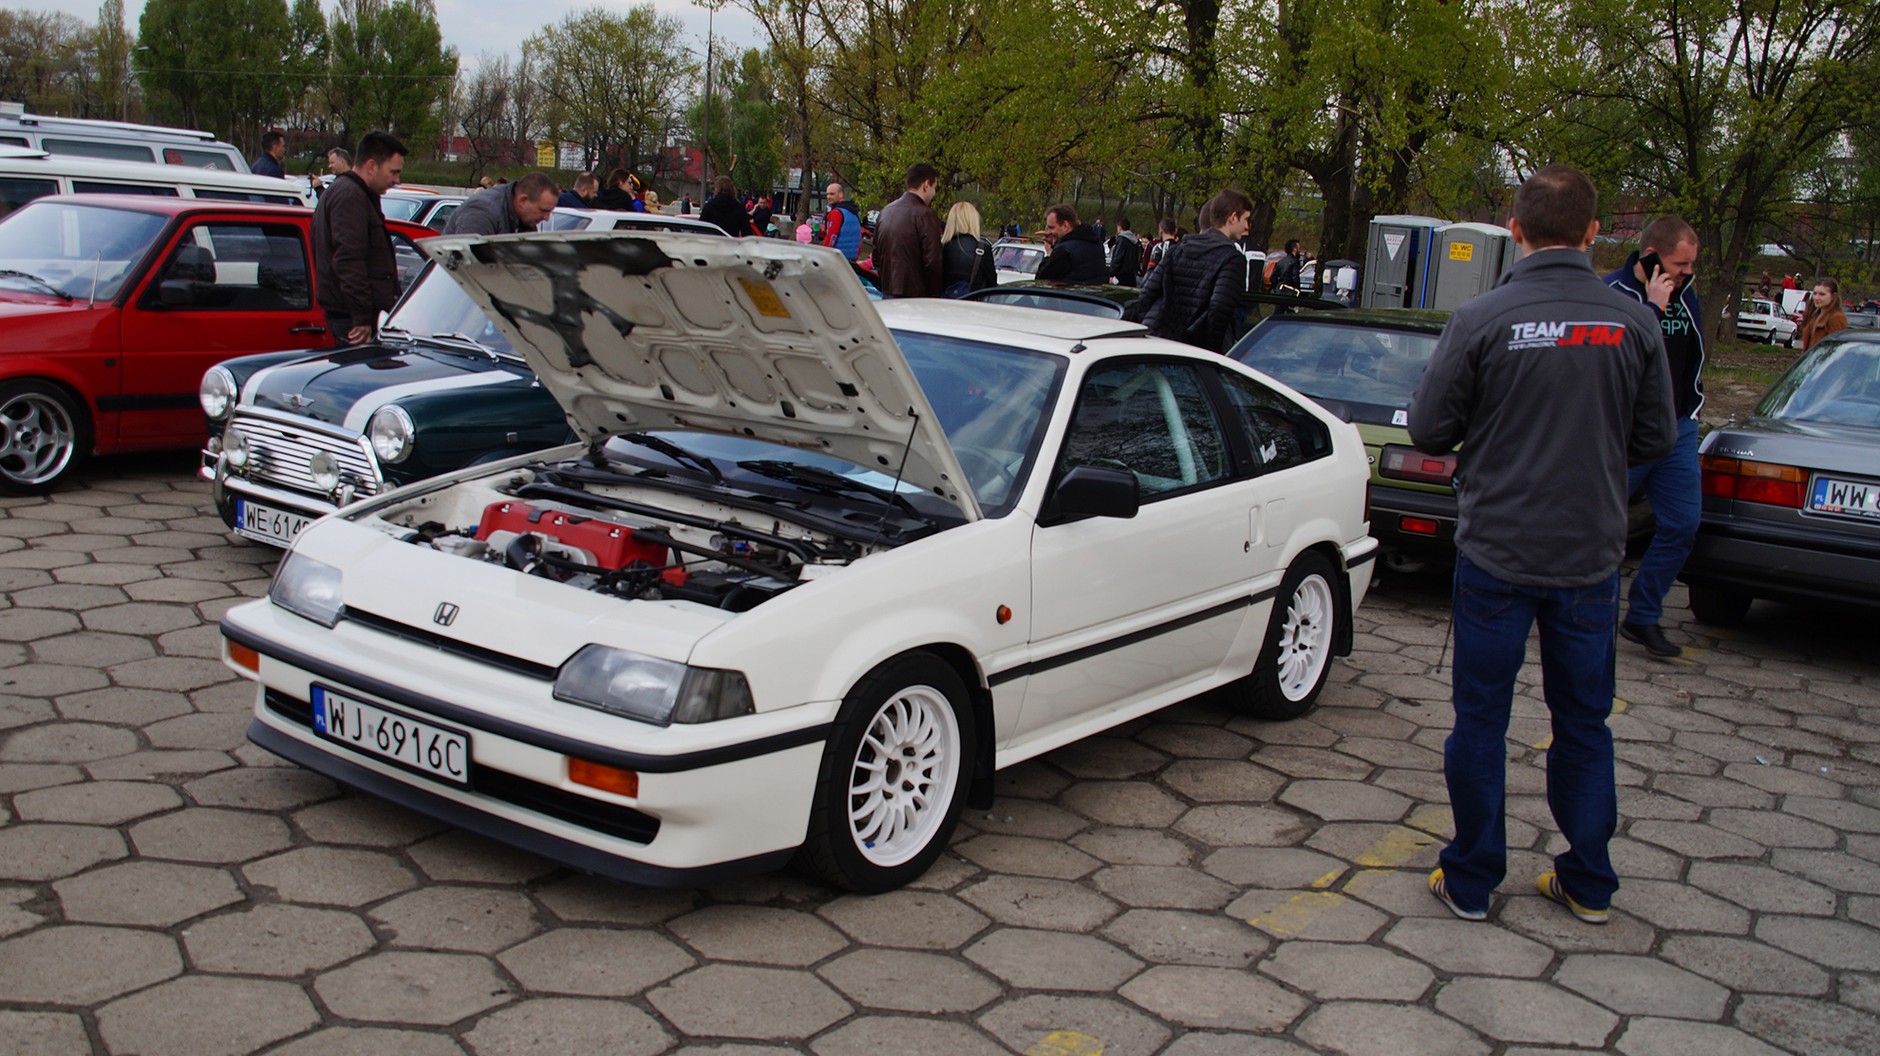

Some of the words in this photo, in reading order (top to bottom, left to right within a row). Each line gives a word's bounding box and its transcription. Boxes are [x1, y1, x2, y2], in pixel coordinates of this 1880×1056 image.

[1511, 321, 1566, 340] TEAM
[1557, 324, 1626, 347] JHM
[1719, 446, 1755, 457] HONDA
[1815, 493, 1825, 502] PL
[1831, 482, 1868, 508] WW
[246, 504, 267, 532] WE
[316, 713, 326, 727] PL
[329, 698, 362, 741] WJ
[377, 716, 462, 776] 6916C
